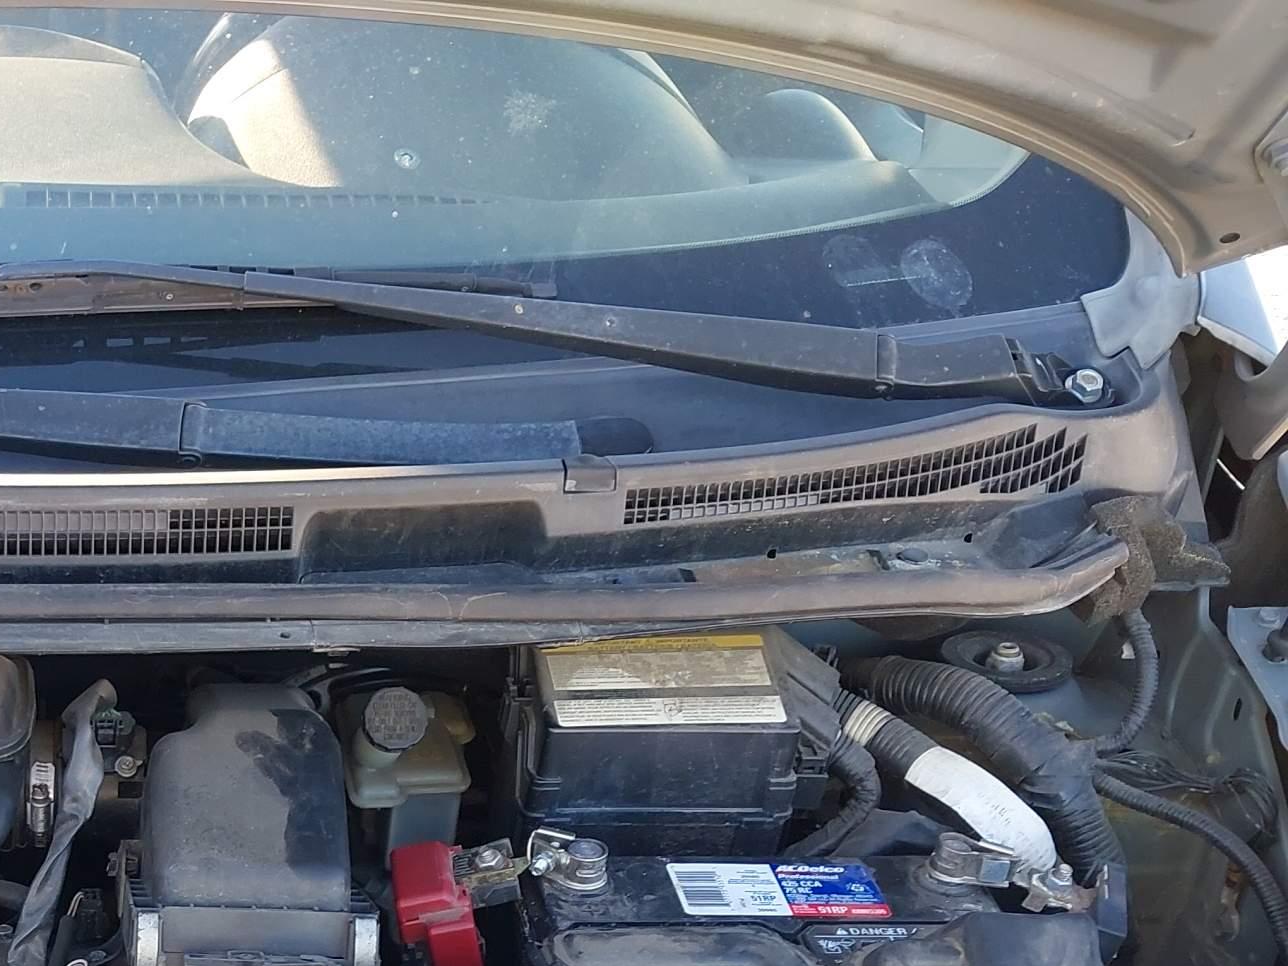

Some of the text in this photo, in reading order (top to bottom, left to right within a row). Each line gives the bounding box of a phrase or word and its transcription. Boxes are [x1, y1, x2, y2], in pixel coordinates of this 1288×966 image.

[775, 864, 845, 874] ACDelco
[799, 880, 823, 888] CCA
[817, 906, 849, 914] 51RP
[848, 927, 908, 936] DANGER
